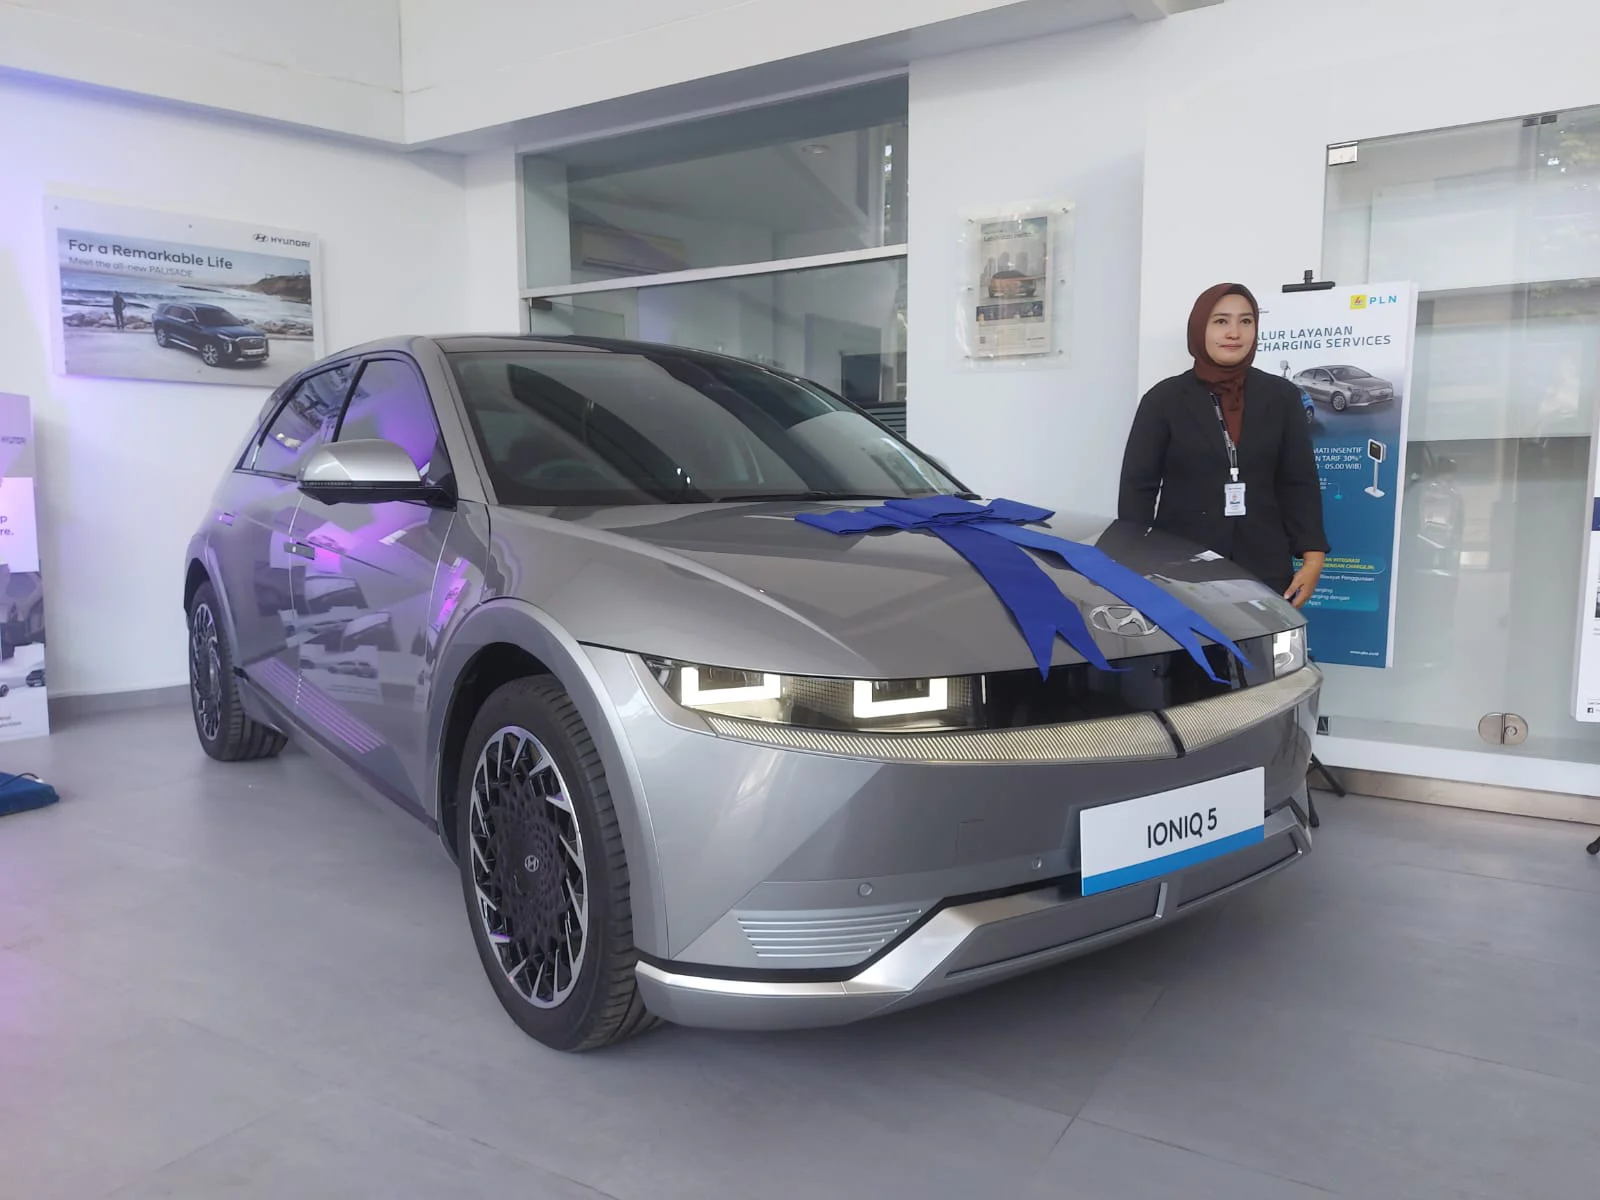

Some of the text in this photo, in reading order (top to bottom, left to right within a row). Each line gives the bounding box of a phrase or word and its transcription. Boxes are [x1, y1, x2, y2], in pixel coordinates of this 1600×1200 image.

[270, 237, 311, 248] HYUNDAI
[69, 239, 233, 270] For a Remarkable Life
[69, 257, 193, 278] Meet the all-new PALISADE
[1369, 295, 1397, 305] PLN
[1290, 326, 1353, 339] LAYANAN
[1257, 335, 1392, 352] CHARGING SERVICES
[1331, 446, 1363, 454] INSENTIF
[1147, 807, 1218, 848] IONIQ 5
